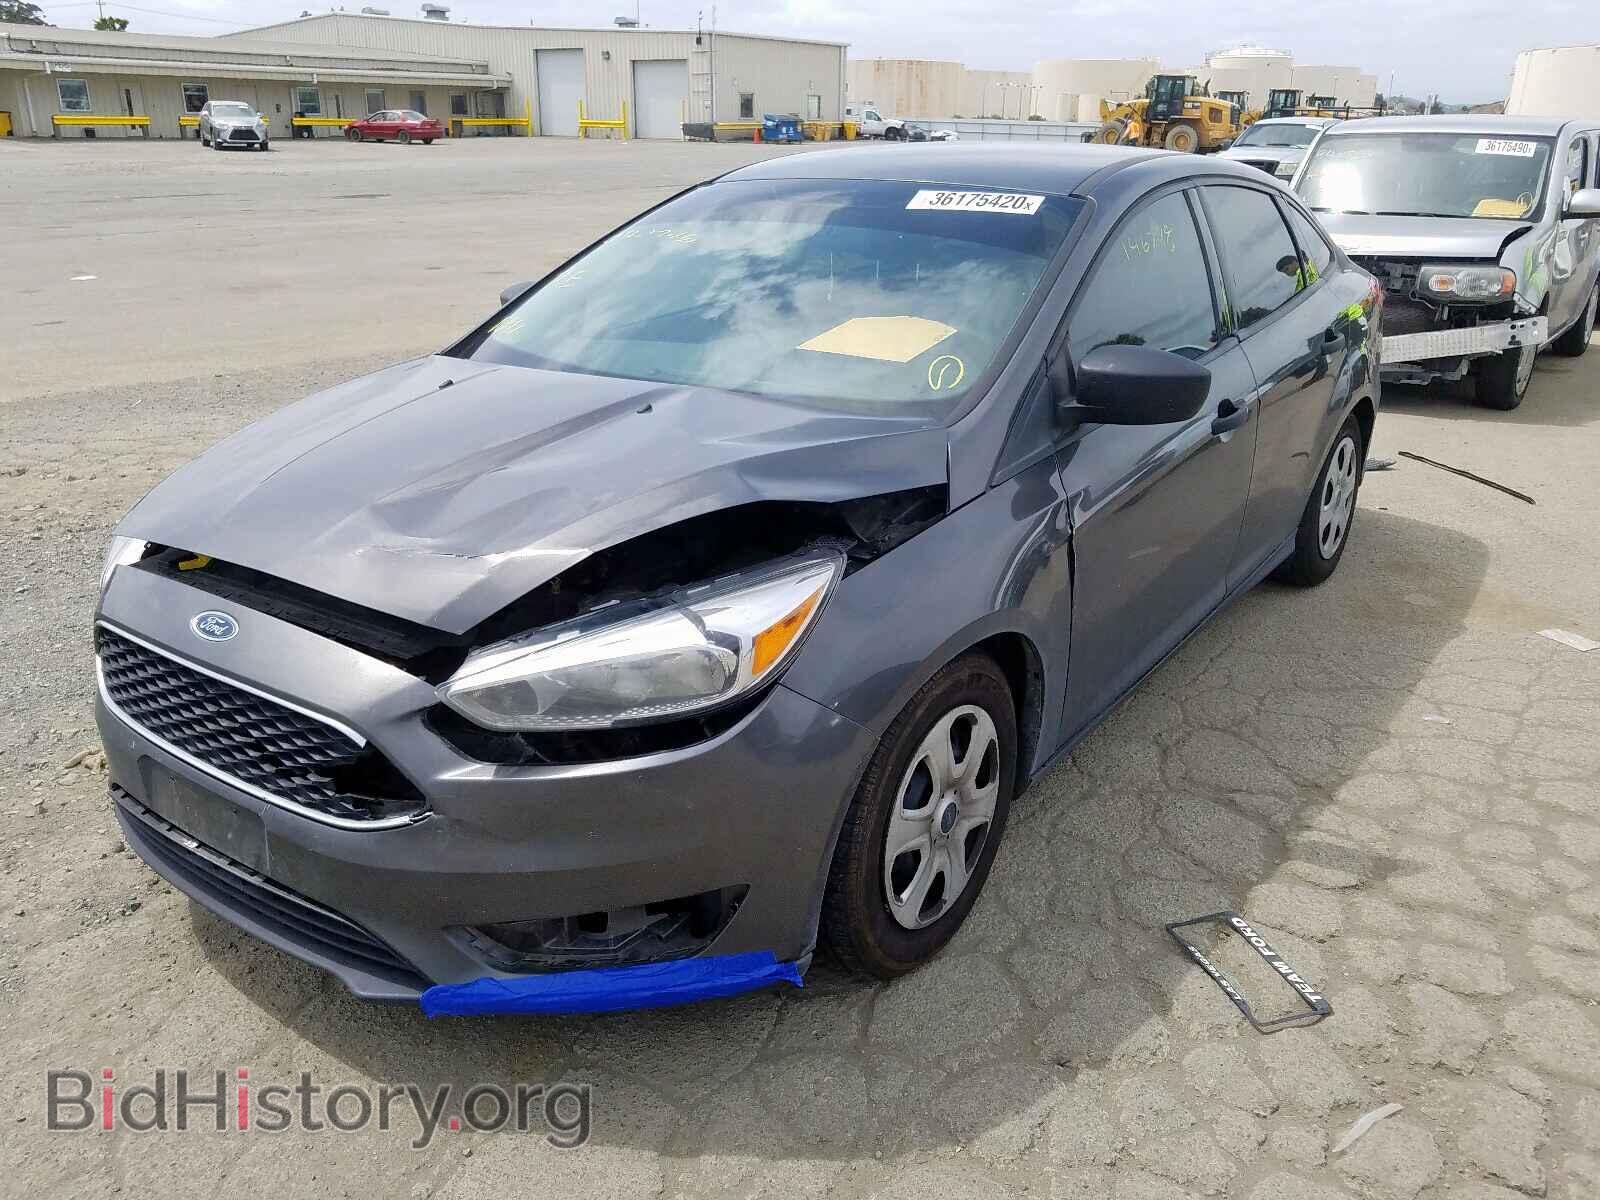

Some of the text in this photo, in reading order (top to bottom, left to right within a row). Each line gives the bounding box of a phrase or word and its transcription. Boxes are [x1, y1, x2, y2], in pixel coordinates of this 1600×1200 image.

[929, 191, 1035, 211] 36175420x
[200, 616, 229, 635] Ford
[1187, 945, 1242, 1000] LAS VEGAS
[1231, 916, 1323, 1003] TEAM FORD
